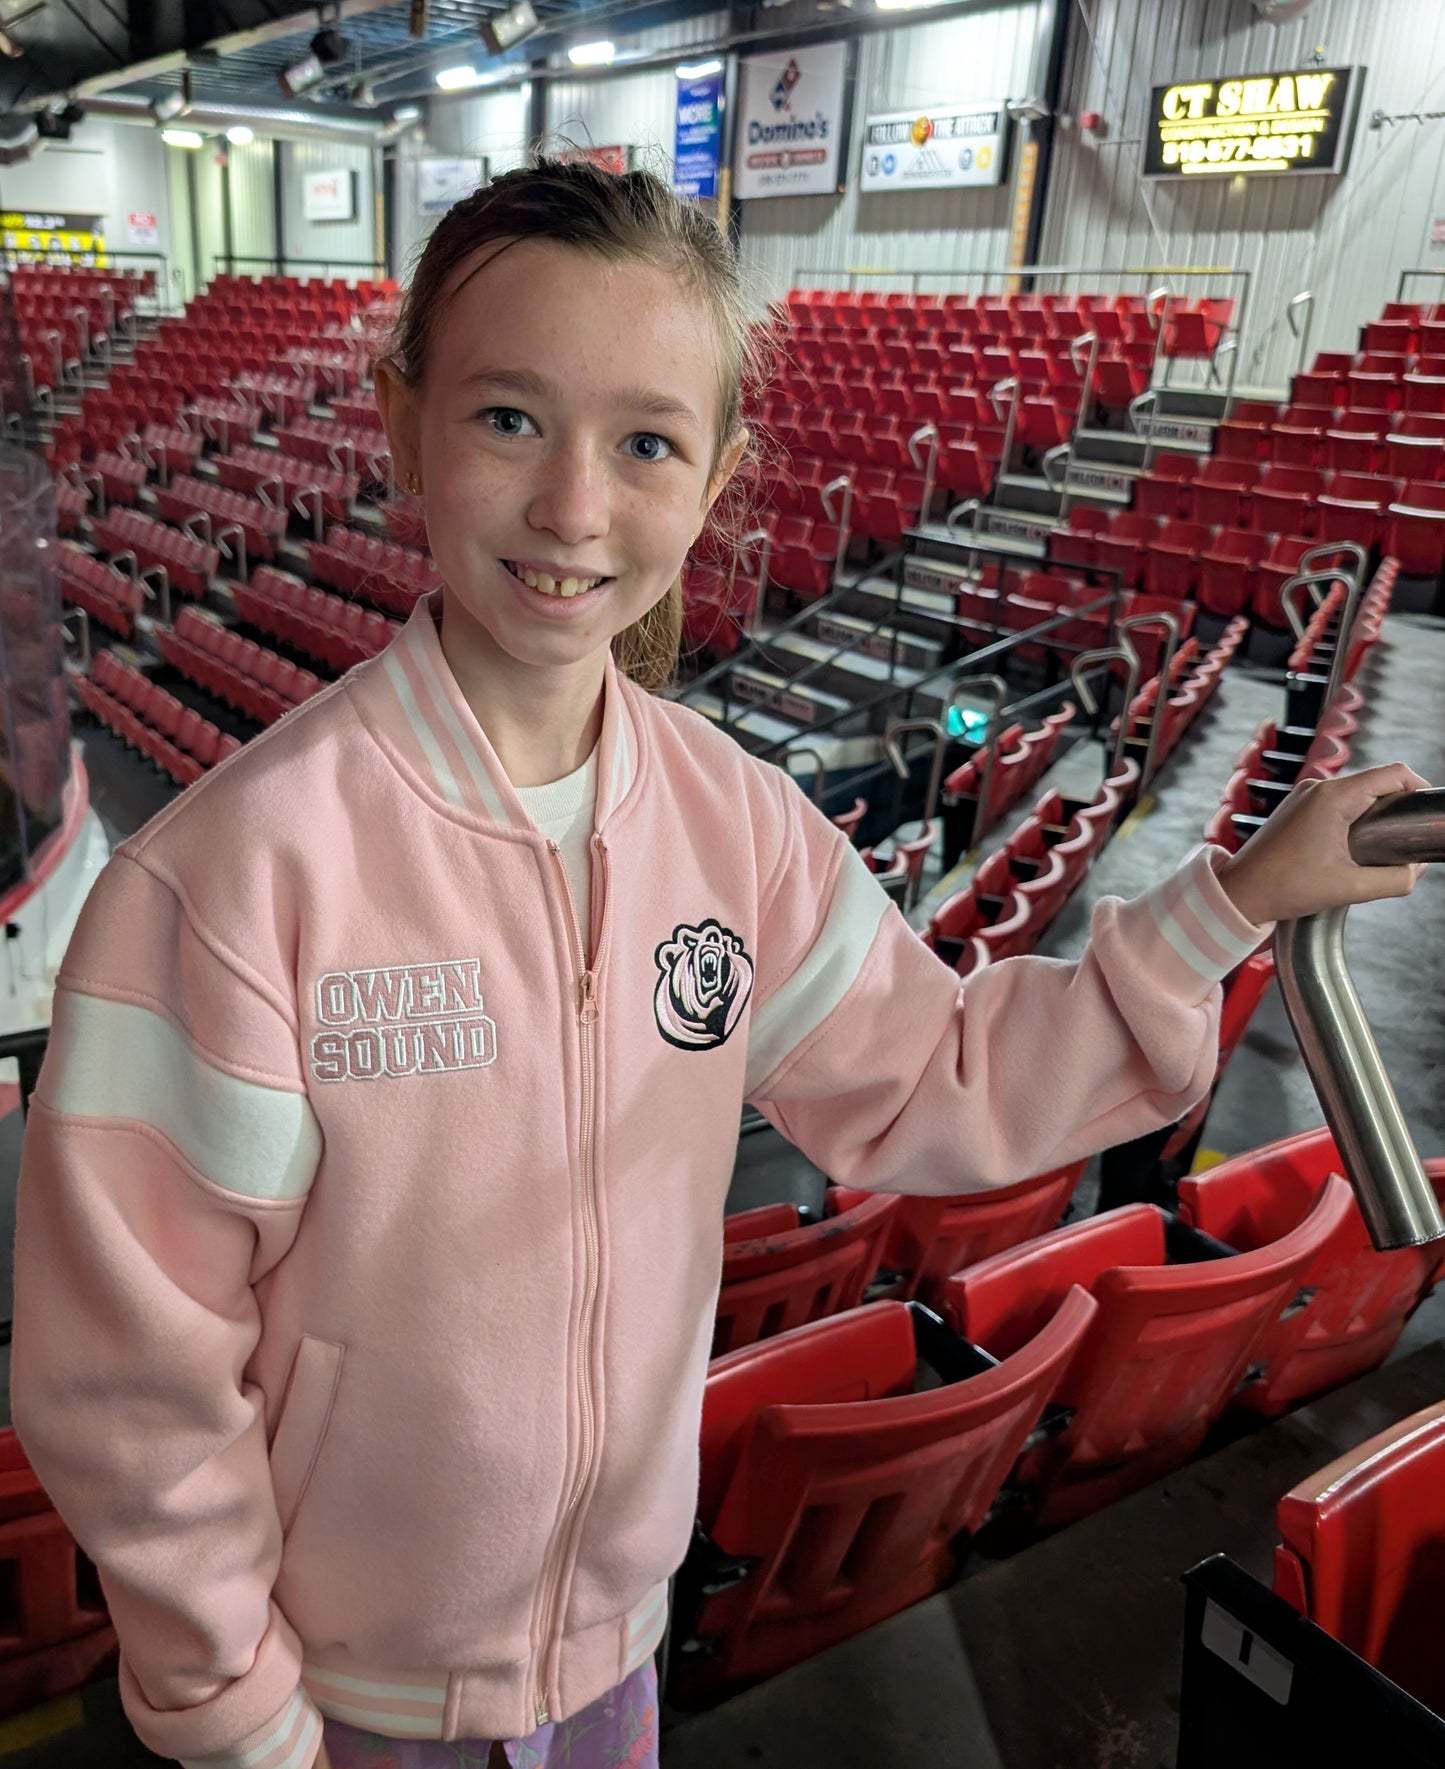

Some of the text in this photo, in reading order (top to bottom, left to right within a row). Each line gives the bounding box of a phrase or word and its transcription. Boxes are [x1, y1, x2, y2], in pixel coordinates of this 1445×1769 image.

[1163, 73, 1334, 120] CT SHAW
[749, 112, 829, 145] Domino's
[315, 958, 483, 1025] OWEN
[310, 1016, 497, 1082] SOUND
